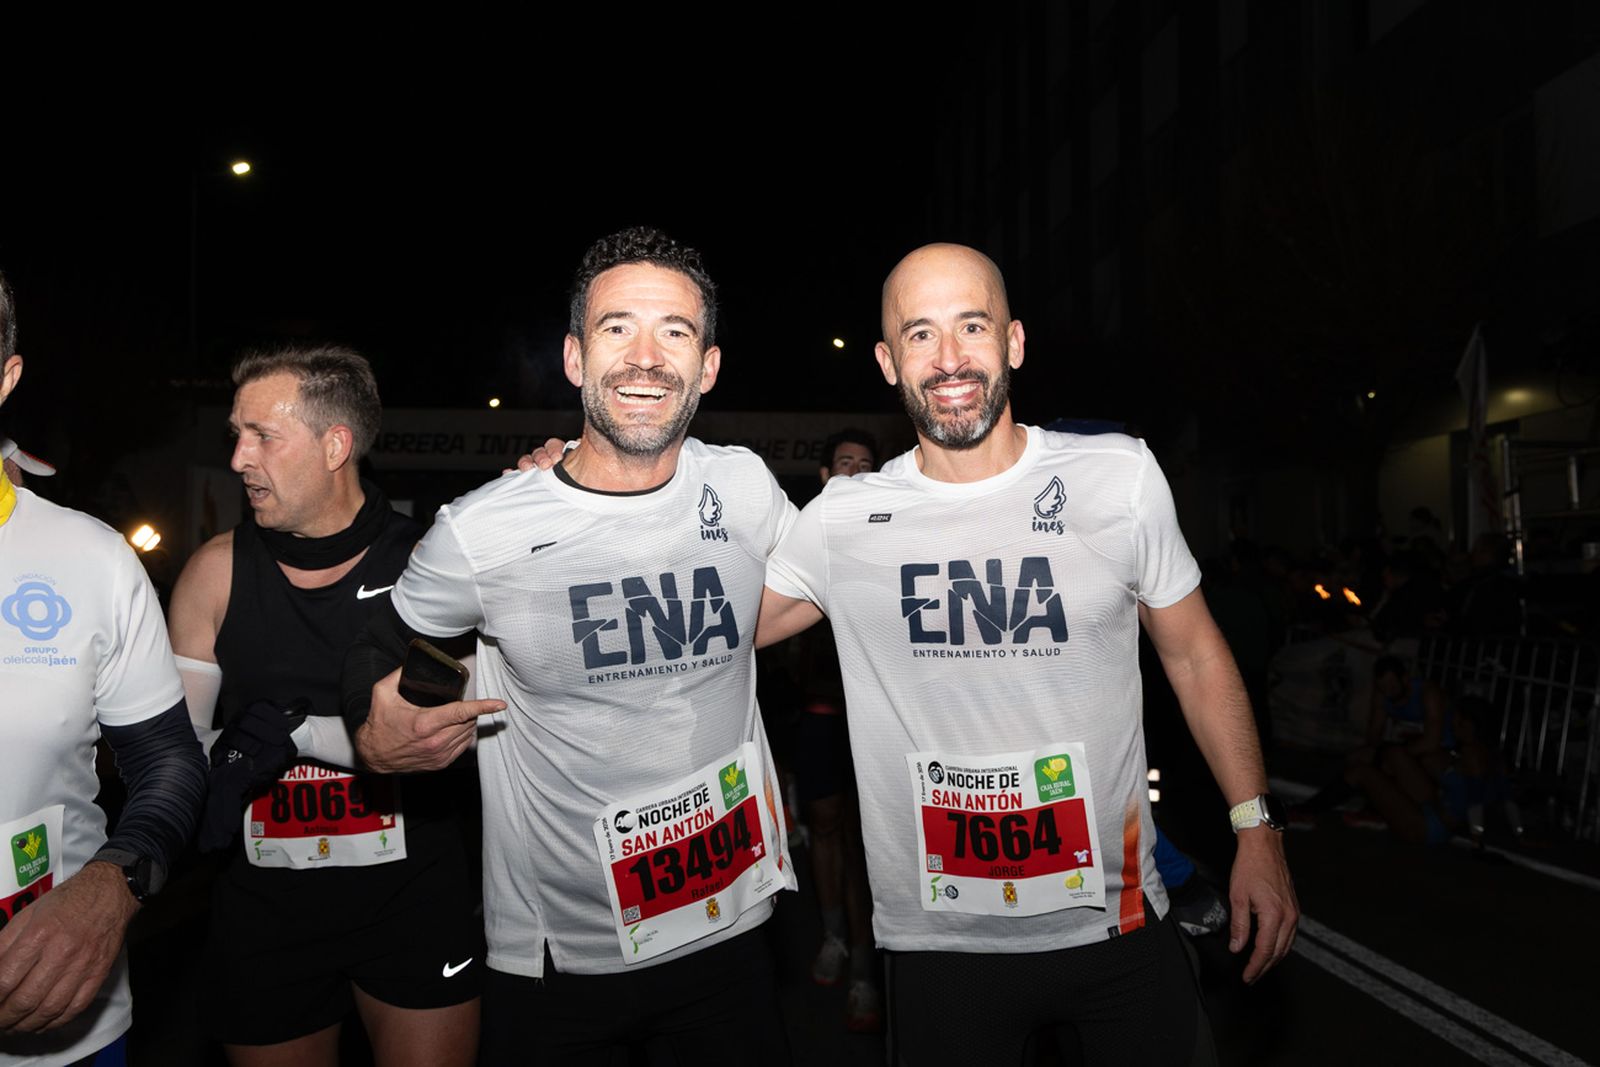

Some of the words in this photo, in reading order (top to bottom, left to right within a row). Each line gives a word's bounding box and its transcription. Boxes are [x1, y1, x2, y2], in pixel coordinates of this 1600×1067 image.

[369, 433, 466, 456] ARRERA
[1031, 515, 1065, 535] inés
[900, 556, 1069, 645] ENA
[568, 566, 740, 669] ENA
[24, 646, 59, 654] GRUPO
[913, 649, 1006, 659] ENTRENAMIENTO
[1011, 649, 1018, 657] Y
[1022, 647, 1061, 657] SALUD
[588, 663, 688, 684] ENTRENAMIENTO
[691, 661, 699, 670] Y
[702, 653, 734, 669] SALUD
[947, 772, 995, 790] NOCHE
[999, 772, 1020, 789] DE
[638, 797, 691, 829] NOCHE
[693, 787, 710, 809] DE
[932, 788, 961, 808] SAN
[965, 789, 1023, 811] ANTÓN
[621, 831, 658, 857] SAN
[662, 806, 715, 845] ANTÓN
[947, 807, 1063, 862] 7664
[629, 807, 752, 902] 13494
[988, 865, 1025, 877] JORGE
[691, 877, 724, 899] Rafael
